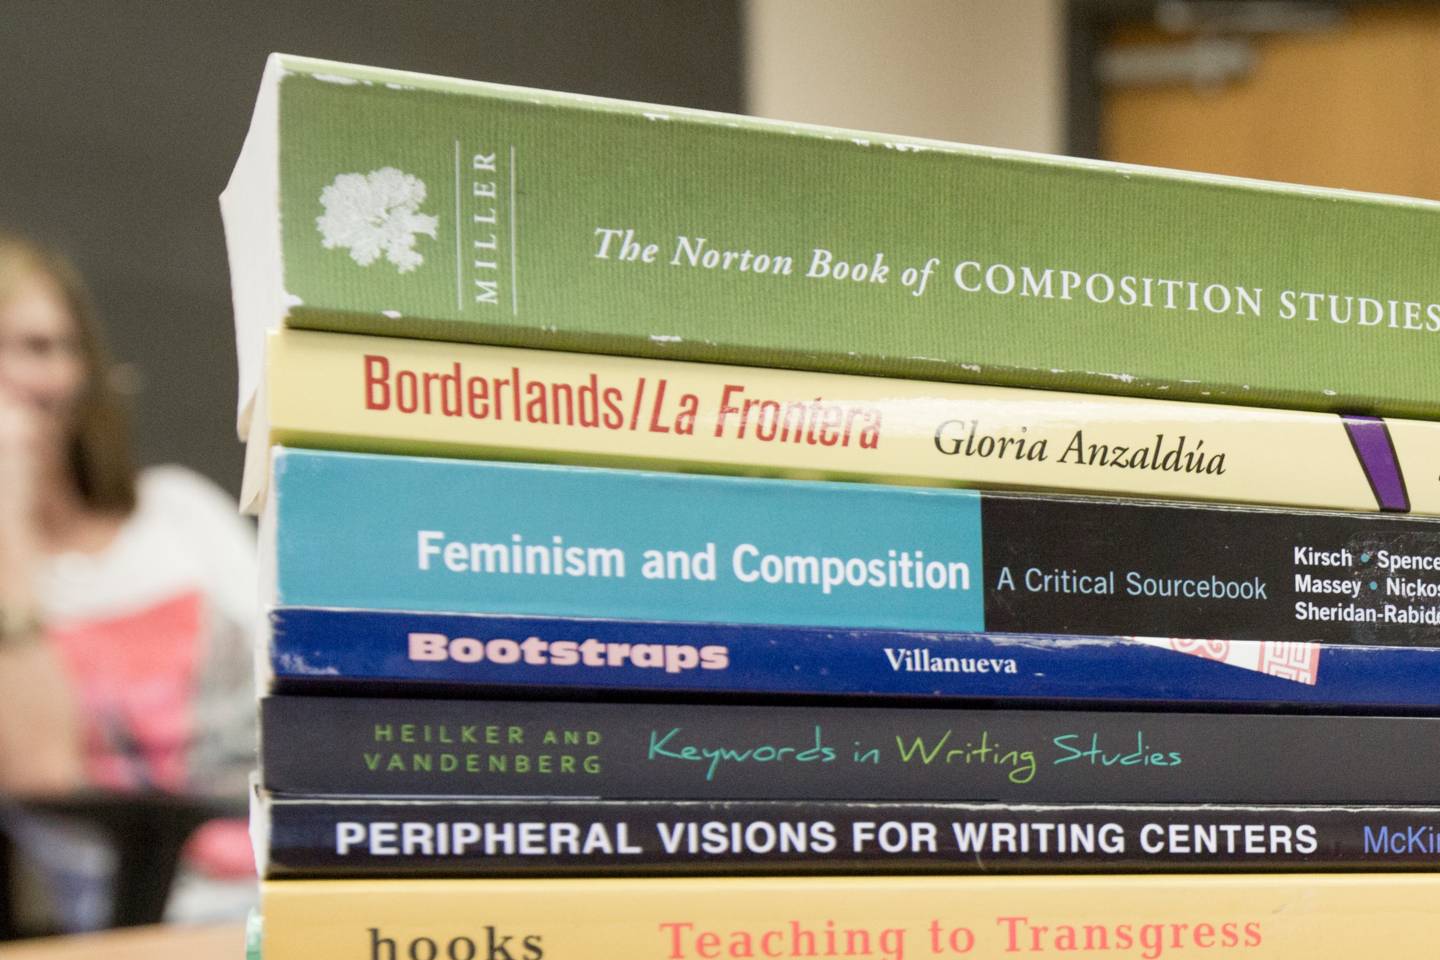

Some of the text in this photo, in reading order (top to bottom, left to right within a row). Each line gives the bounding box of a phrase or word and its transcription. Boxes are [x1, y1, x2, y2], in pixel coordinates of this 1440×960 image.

[473, 151, 498, 304] MILLER
[594, 227, 659, 263] The
[670, 236, 794, 275] Norton
[806, 248, 890, 284] Book
[901, 258, 940, 296] of
[954, 260, 1263, 316] COMPOSITION
[713, 384, 884, 450] Frontera
[932, 419, 1227, 477] Gloria Anzaldúa
[417, 530, 971, 593] Feminism and Composition
[1294, 546, 1352, 567] Kirsch
[997, 566, 1267, 600] A Critical Sourcebook
[1295, 575, 1361, 598] Massey
[408, 633, 729, 673] Bootstraps
[884, 648, 1017, 675] Villanueva
[374, 724, 600, 745] HEILKER AND
[649, 726, 1182, 783] Keywords in Writing Studies
[364, 753, 600, 773] VANDENBERG
[336, 821, 1318, 855] PERIPHERAL VISIONS FOR WRITING CENTERS
[929, 919, 975, 954] to
[997, 916, 1263, 960] Transgress
